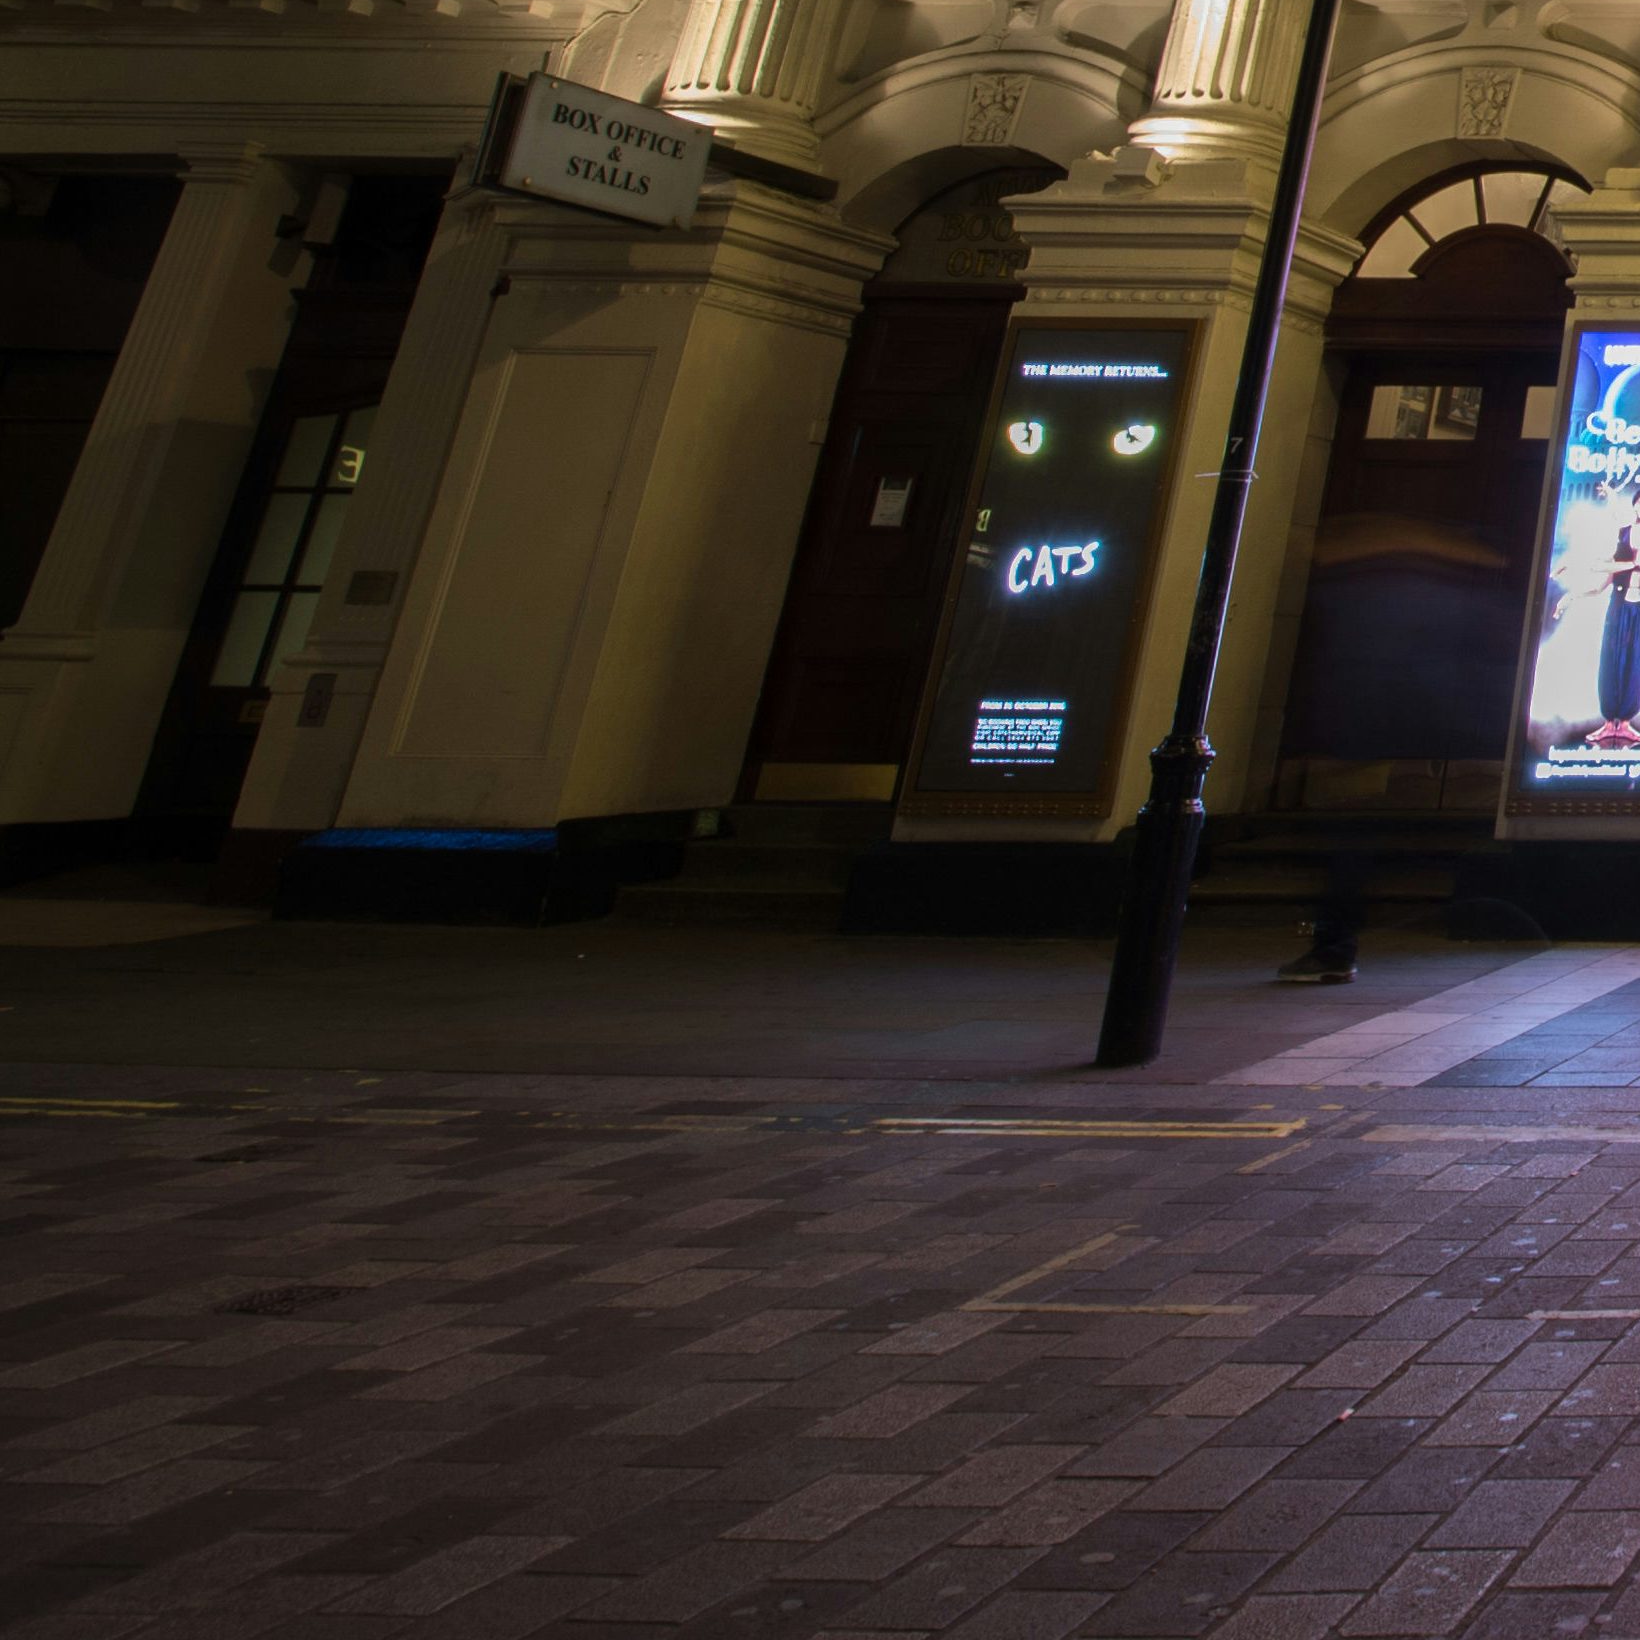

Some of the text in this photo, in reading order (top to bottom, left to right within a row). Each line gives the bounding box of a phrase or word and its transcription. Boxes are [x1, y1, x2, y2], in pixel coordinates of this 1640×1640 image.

[552, 103, 687, 160] BOX OFFICE
[608, 147, 623, 163] &
[566, 156, 652, 195] STALLS
[1023, 364, 1048, 375] THE
[1049, 364, 1103, 376] MEMORY
[1230, 436, 1244, 455] 7
[1008, 541, 1100, 594] CATS
